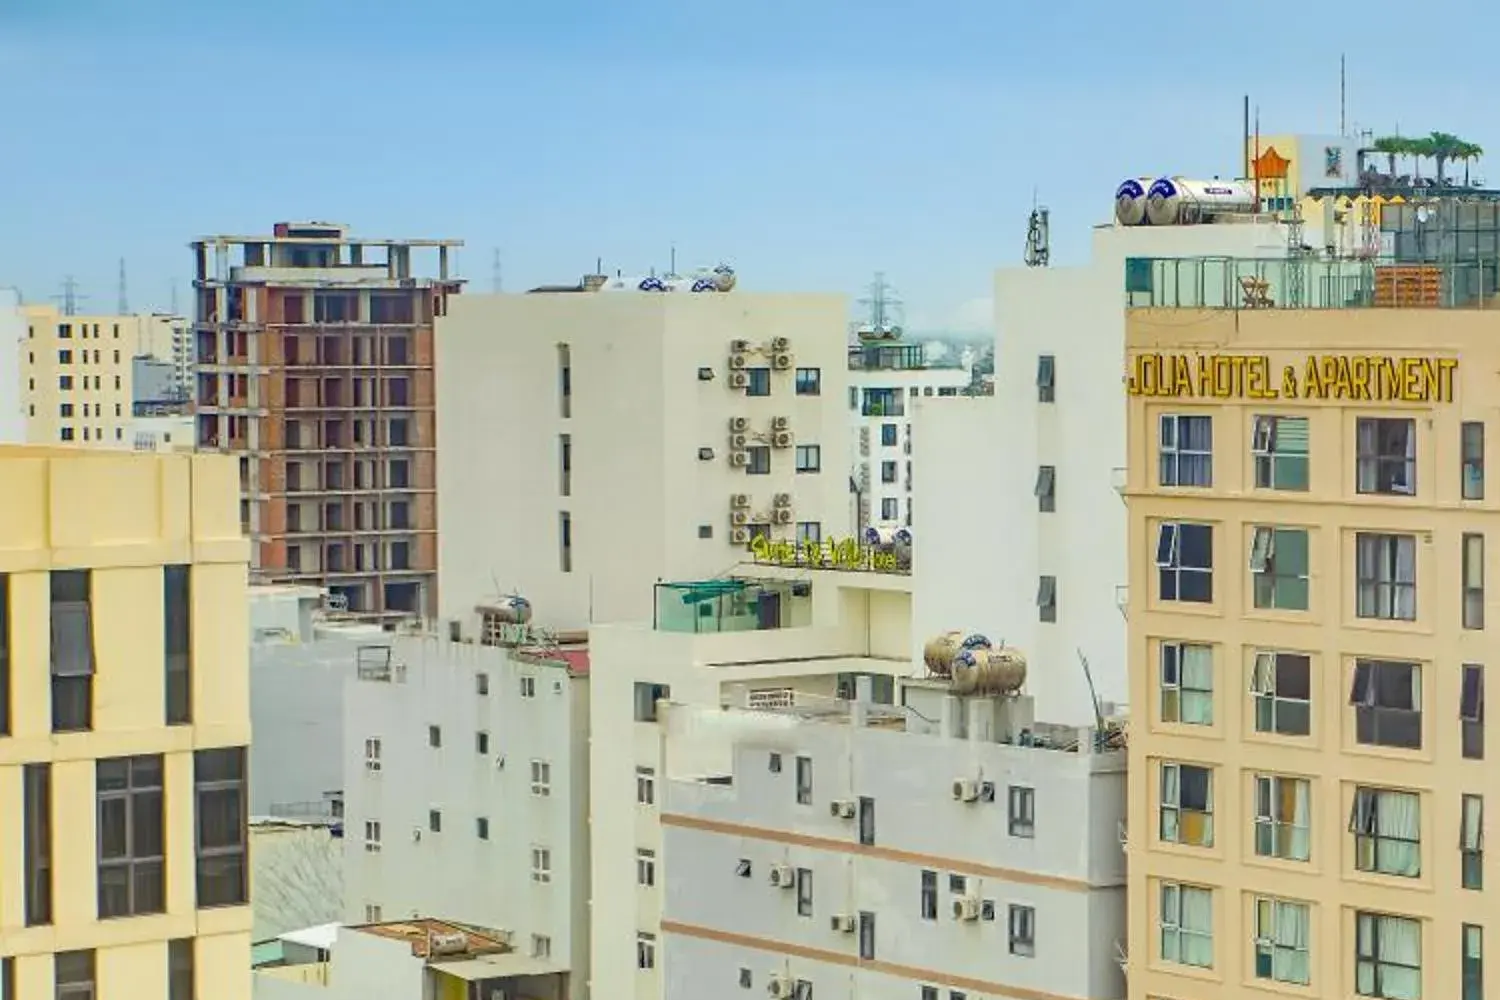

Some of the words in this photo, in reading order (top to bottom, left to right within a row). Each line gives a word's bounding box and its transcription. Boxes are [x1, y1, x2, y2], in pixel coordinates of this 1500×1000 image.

[1196, 354, 1280, 399] HOTEL
[1283, 365, 1299, 399] &
[1303, 355, 1459, 402] APARTMENT
